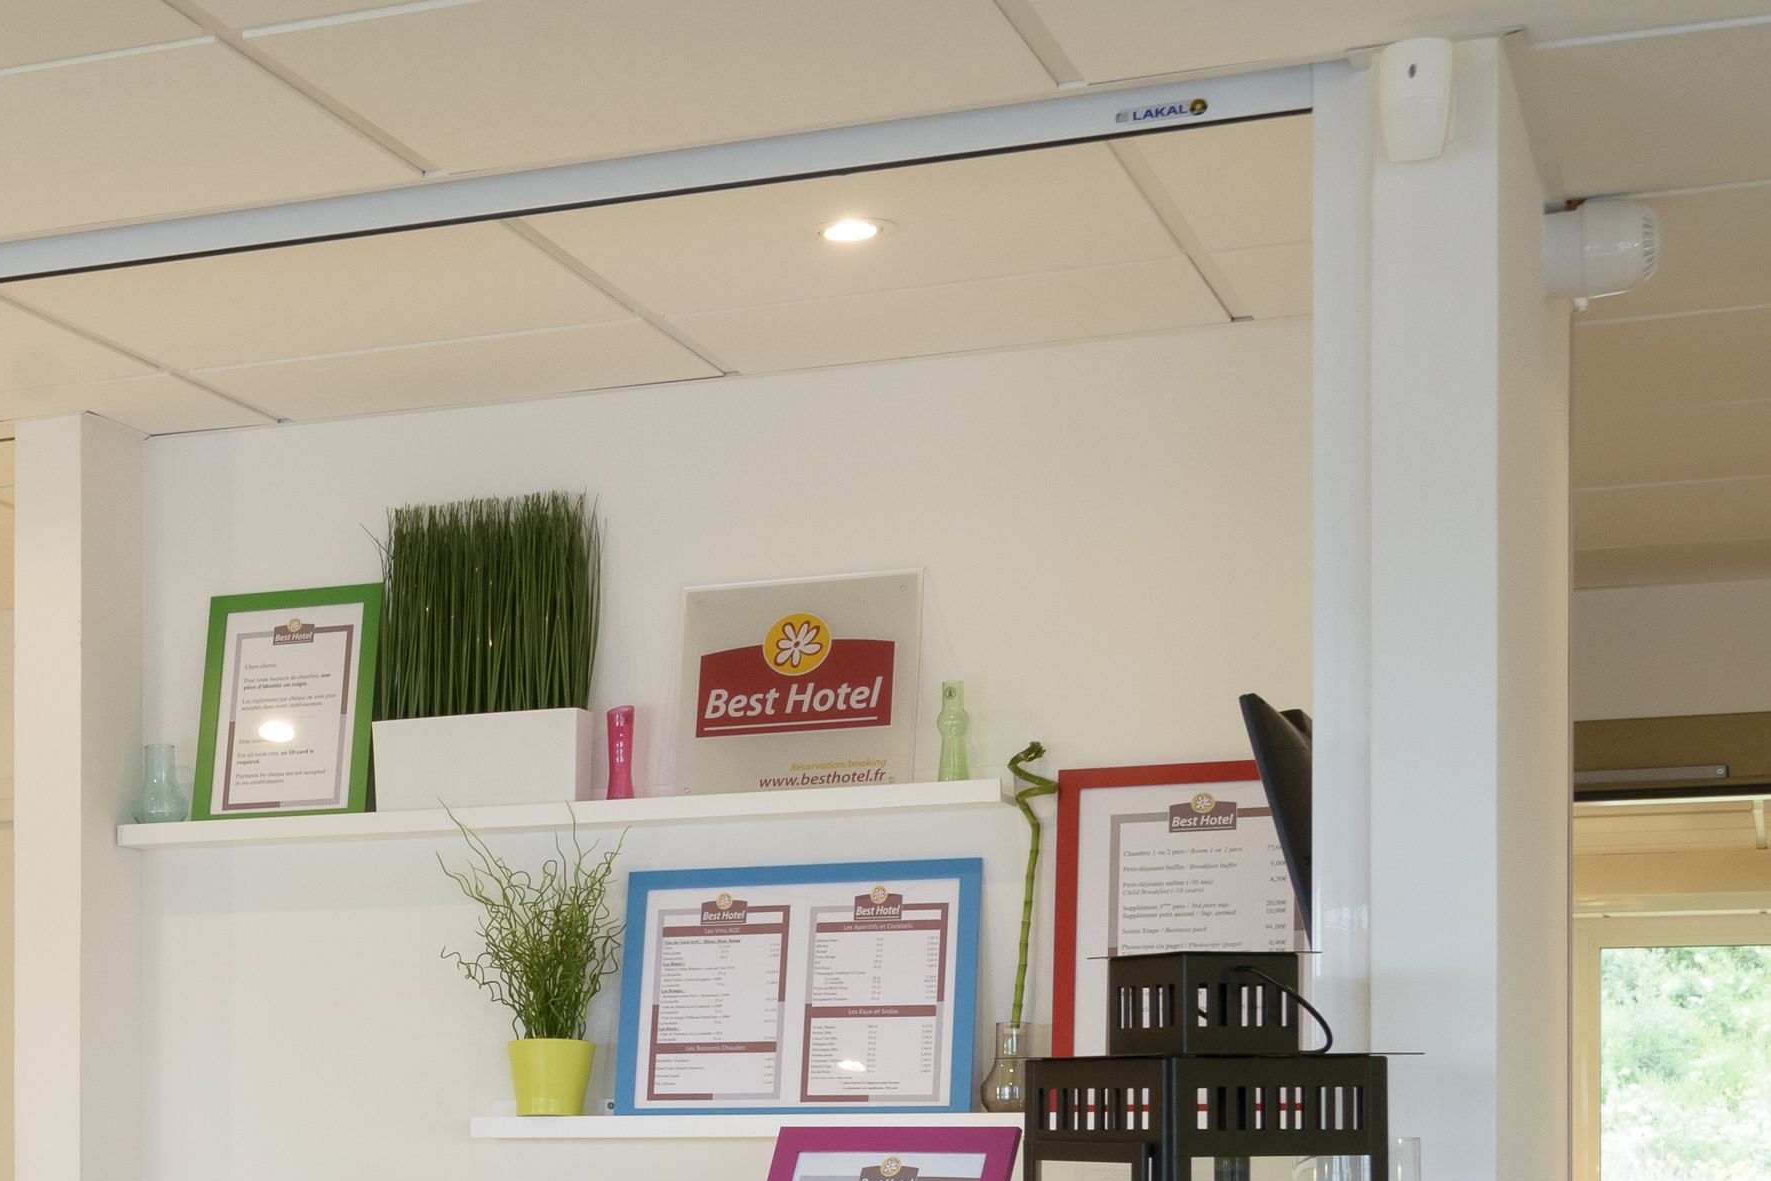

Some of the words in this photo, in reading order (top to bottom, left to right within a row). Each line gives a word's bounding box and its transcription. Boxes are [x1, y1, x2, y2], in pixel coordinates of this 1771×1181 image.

[275, 633, 291, 642] Best
[292, 631, 312, 640] Hotel
[704, 688, 779, 719] Best
[785, 676, 883, 714] Hotel
[759, 769, 886, 788] www.besthotel.fr
[1172, 816, 1198, 827] Best
[1200, 814, 1234, 825] Hotel
[703, 912, 721, 920] Best
[722, 911, 745, 920] Hotel
[856, 906, 874, 916] Best
[876, 905, 900, 915] Hotel
